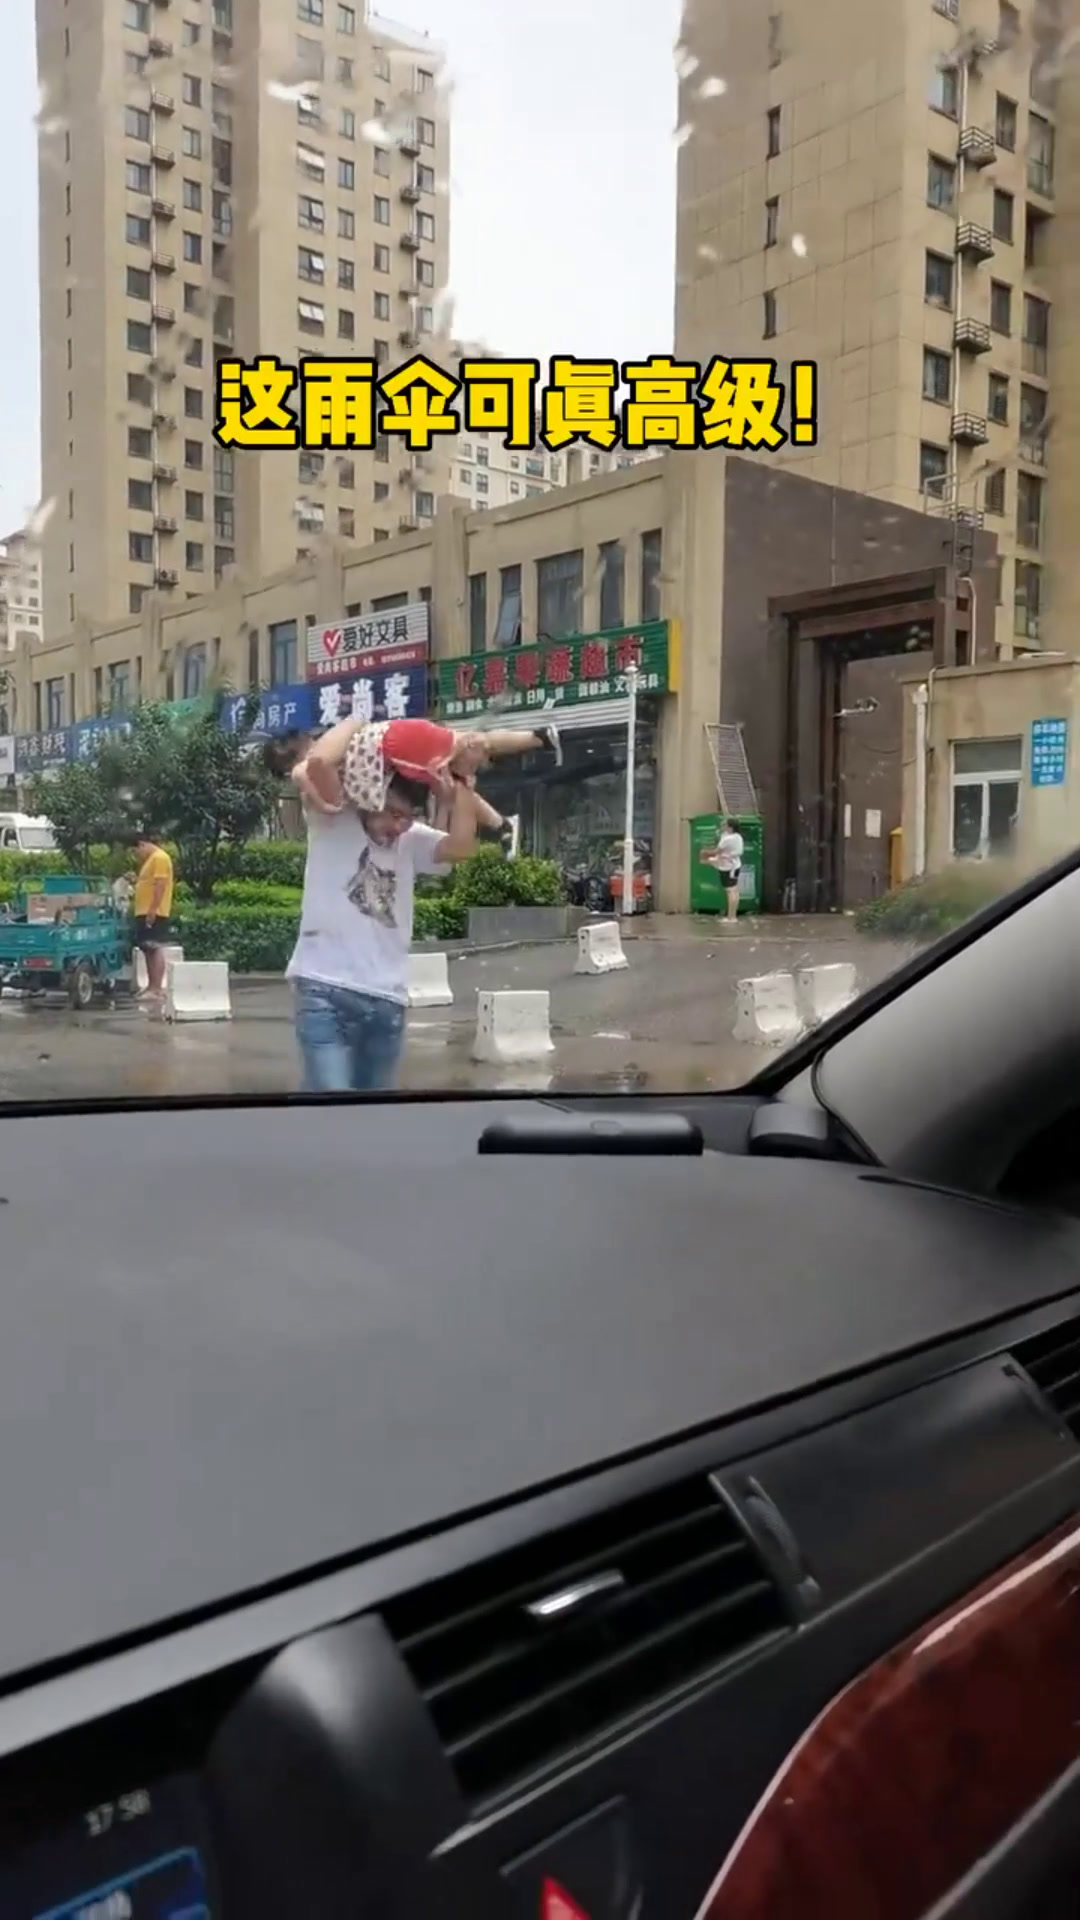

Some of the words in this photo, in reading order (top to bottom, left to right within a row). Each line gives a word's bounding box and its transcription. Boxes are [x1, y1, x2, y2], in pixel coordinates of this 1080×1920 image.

[343, 615, 408, 652] 爱好文具
[319, 672, 411, 726] 爱尚客
